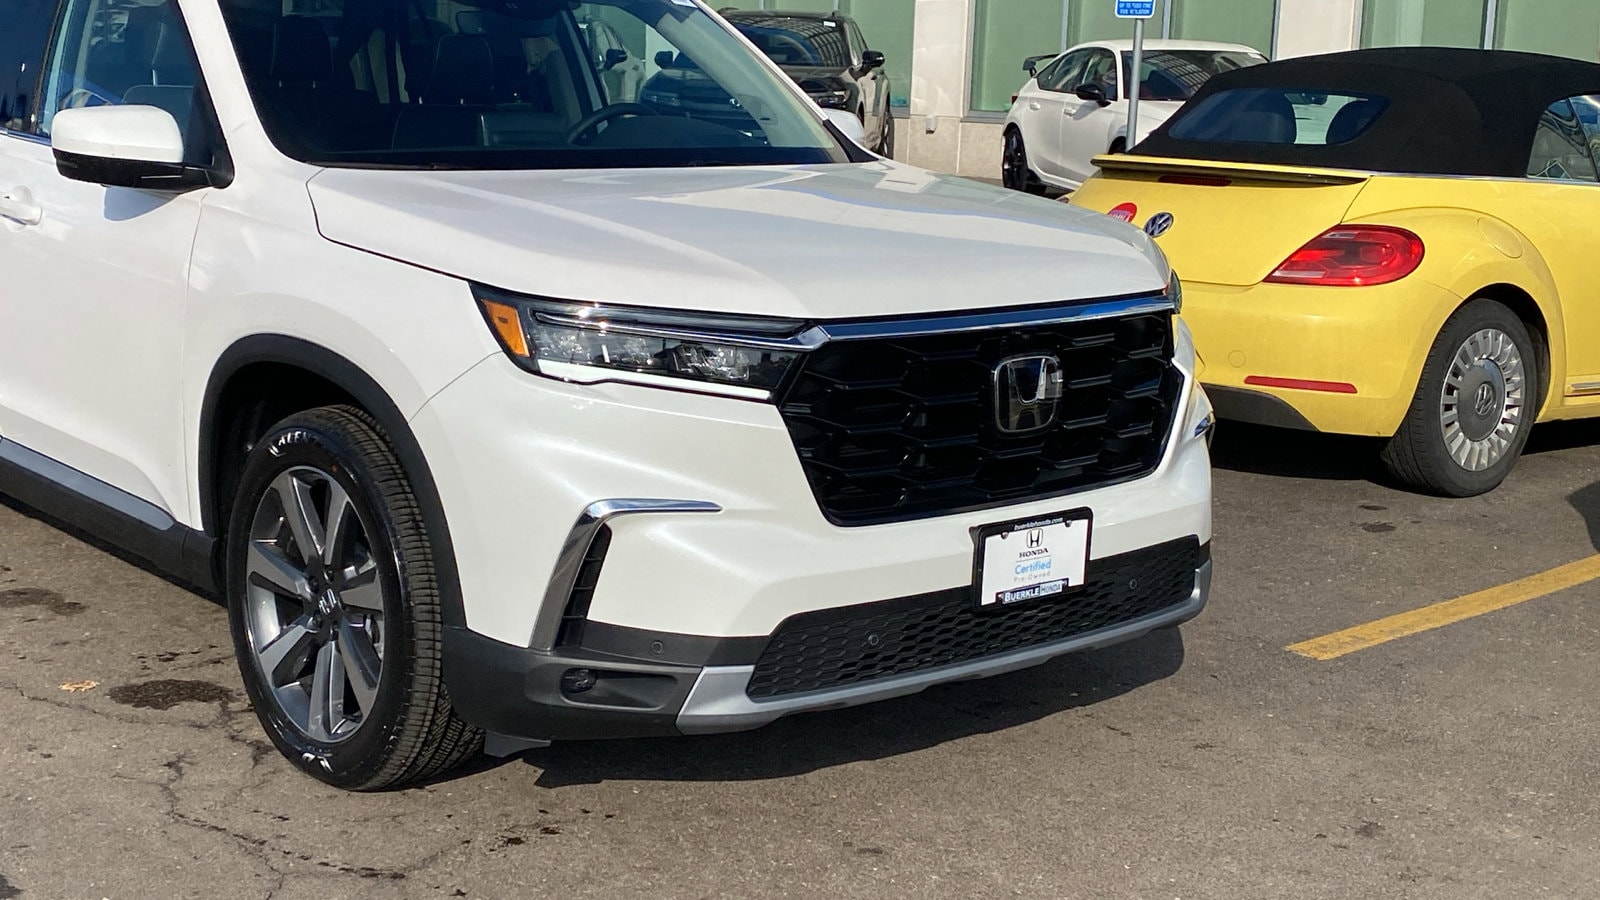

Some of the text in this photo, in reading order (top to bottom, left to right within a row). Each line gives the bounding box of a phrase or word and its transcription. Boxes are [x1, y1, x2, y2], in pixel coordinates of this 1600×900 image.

[1019, 548, 1049, 558] HONDA
[1015, 559, 1052, 575] Certified
[1005, 587, 1040, 602] BUERKLE
